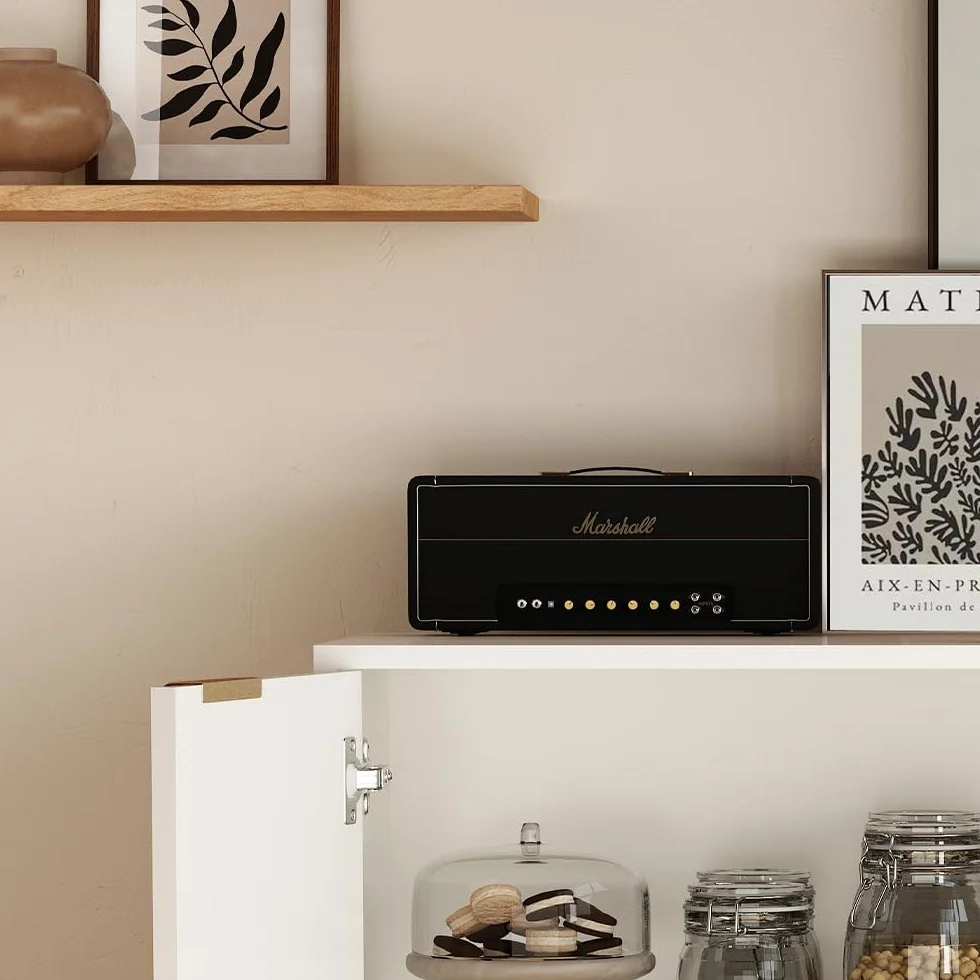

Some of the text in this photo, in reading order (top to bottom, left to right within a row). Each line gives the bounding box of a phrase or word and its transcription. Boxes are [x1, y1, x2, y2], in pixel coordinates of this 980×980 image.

[572, 511, 657, 535] Marshall
[892, 601, 952, 612] Pavillon
[959, 601, 975, 612] de
